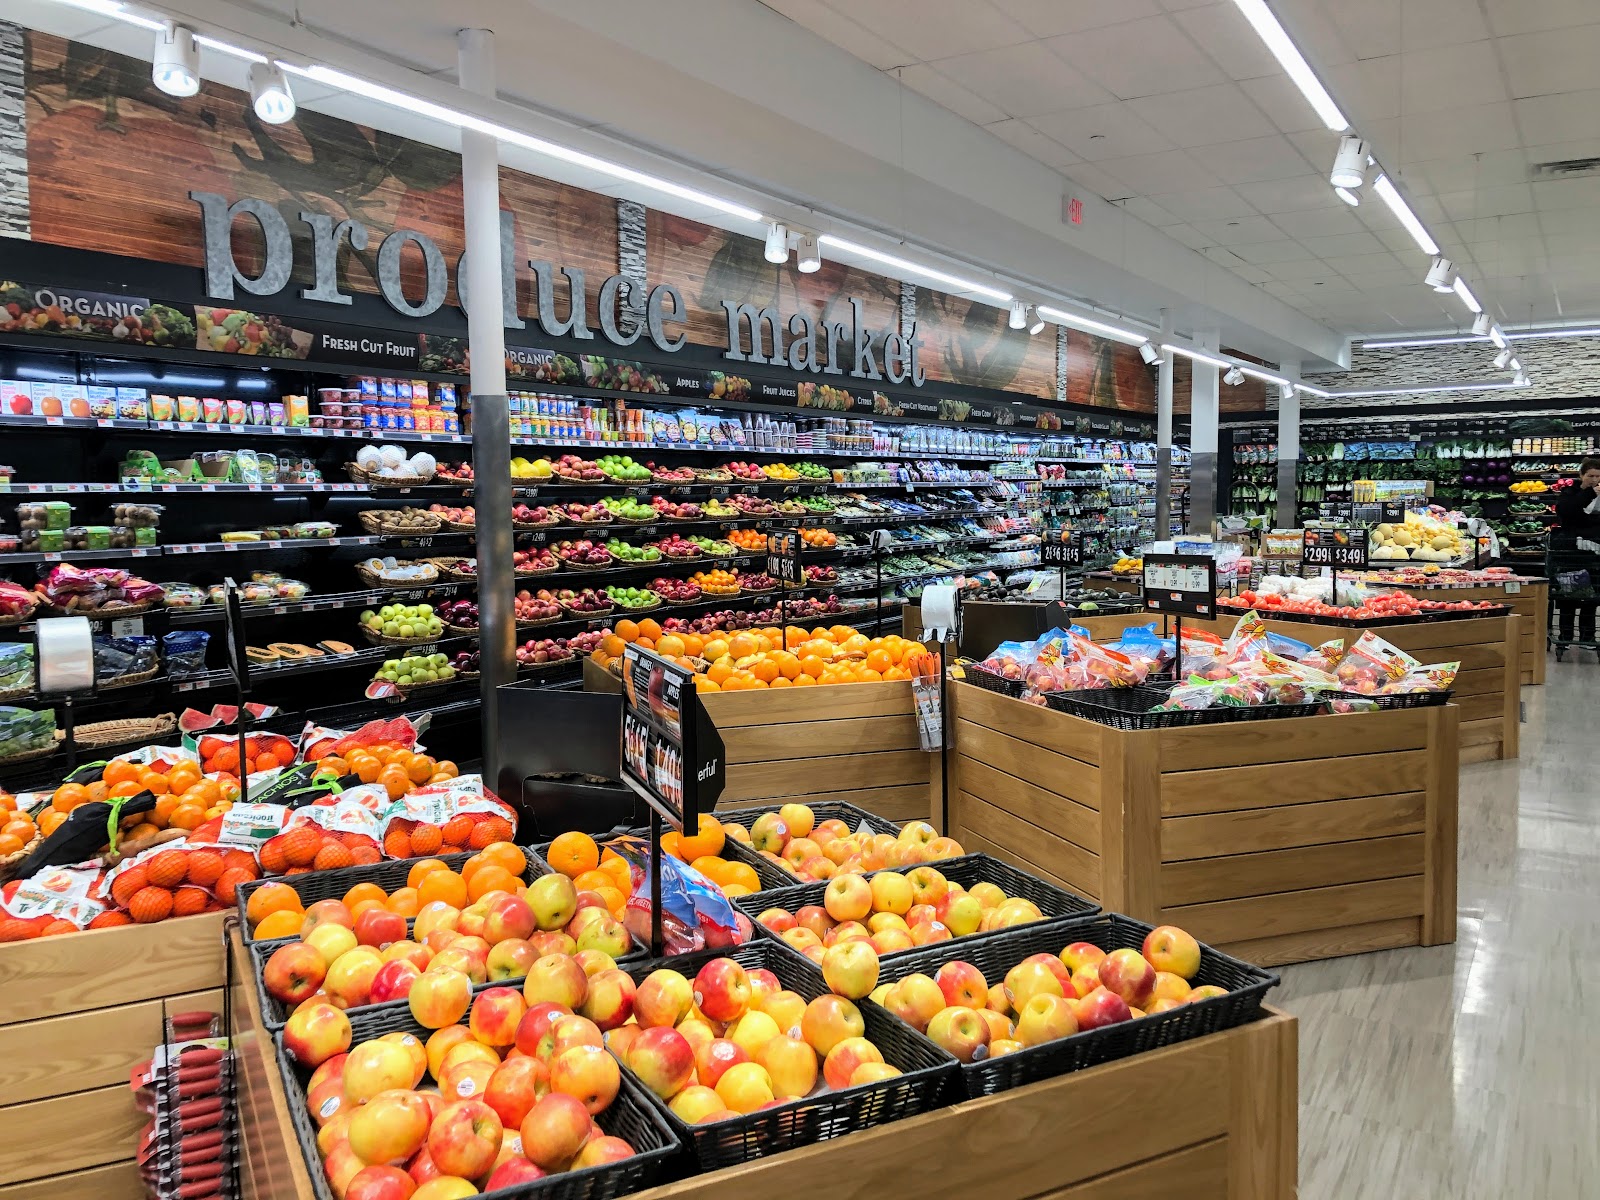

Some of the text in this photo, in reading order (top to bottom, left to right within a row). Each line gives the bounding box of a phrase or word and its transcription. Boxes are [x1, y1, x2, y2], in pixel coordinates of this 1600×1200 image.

[34, 289, 145, 320] ORGANIC
[322, 334, 416, 358] FRESH CUT FRUIT
[721, 297, 926, 388] market
[676, 376, 700, 389] APPLES
[763, 385, 797, 397] FRUIT JUICES
[1335, 548, 1360, 563] $3.49
